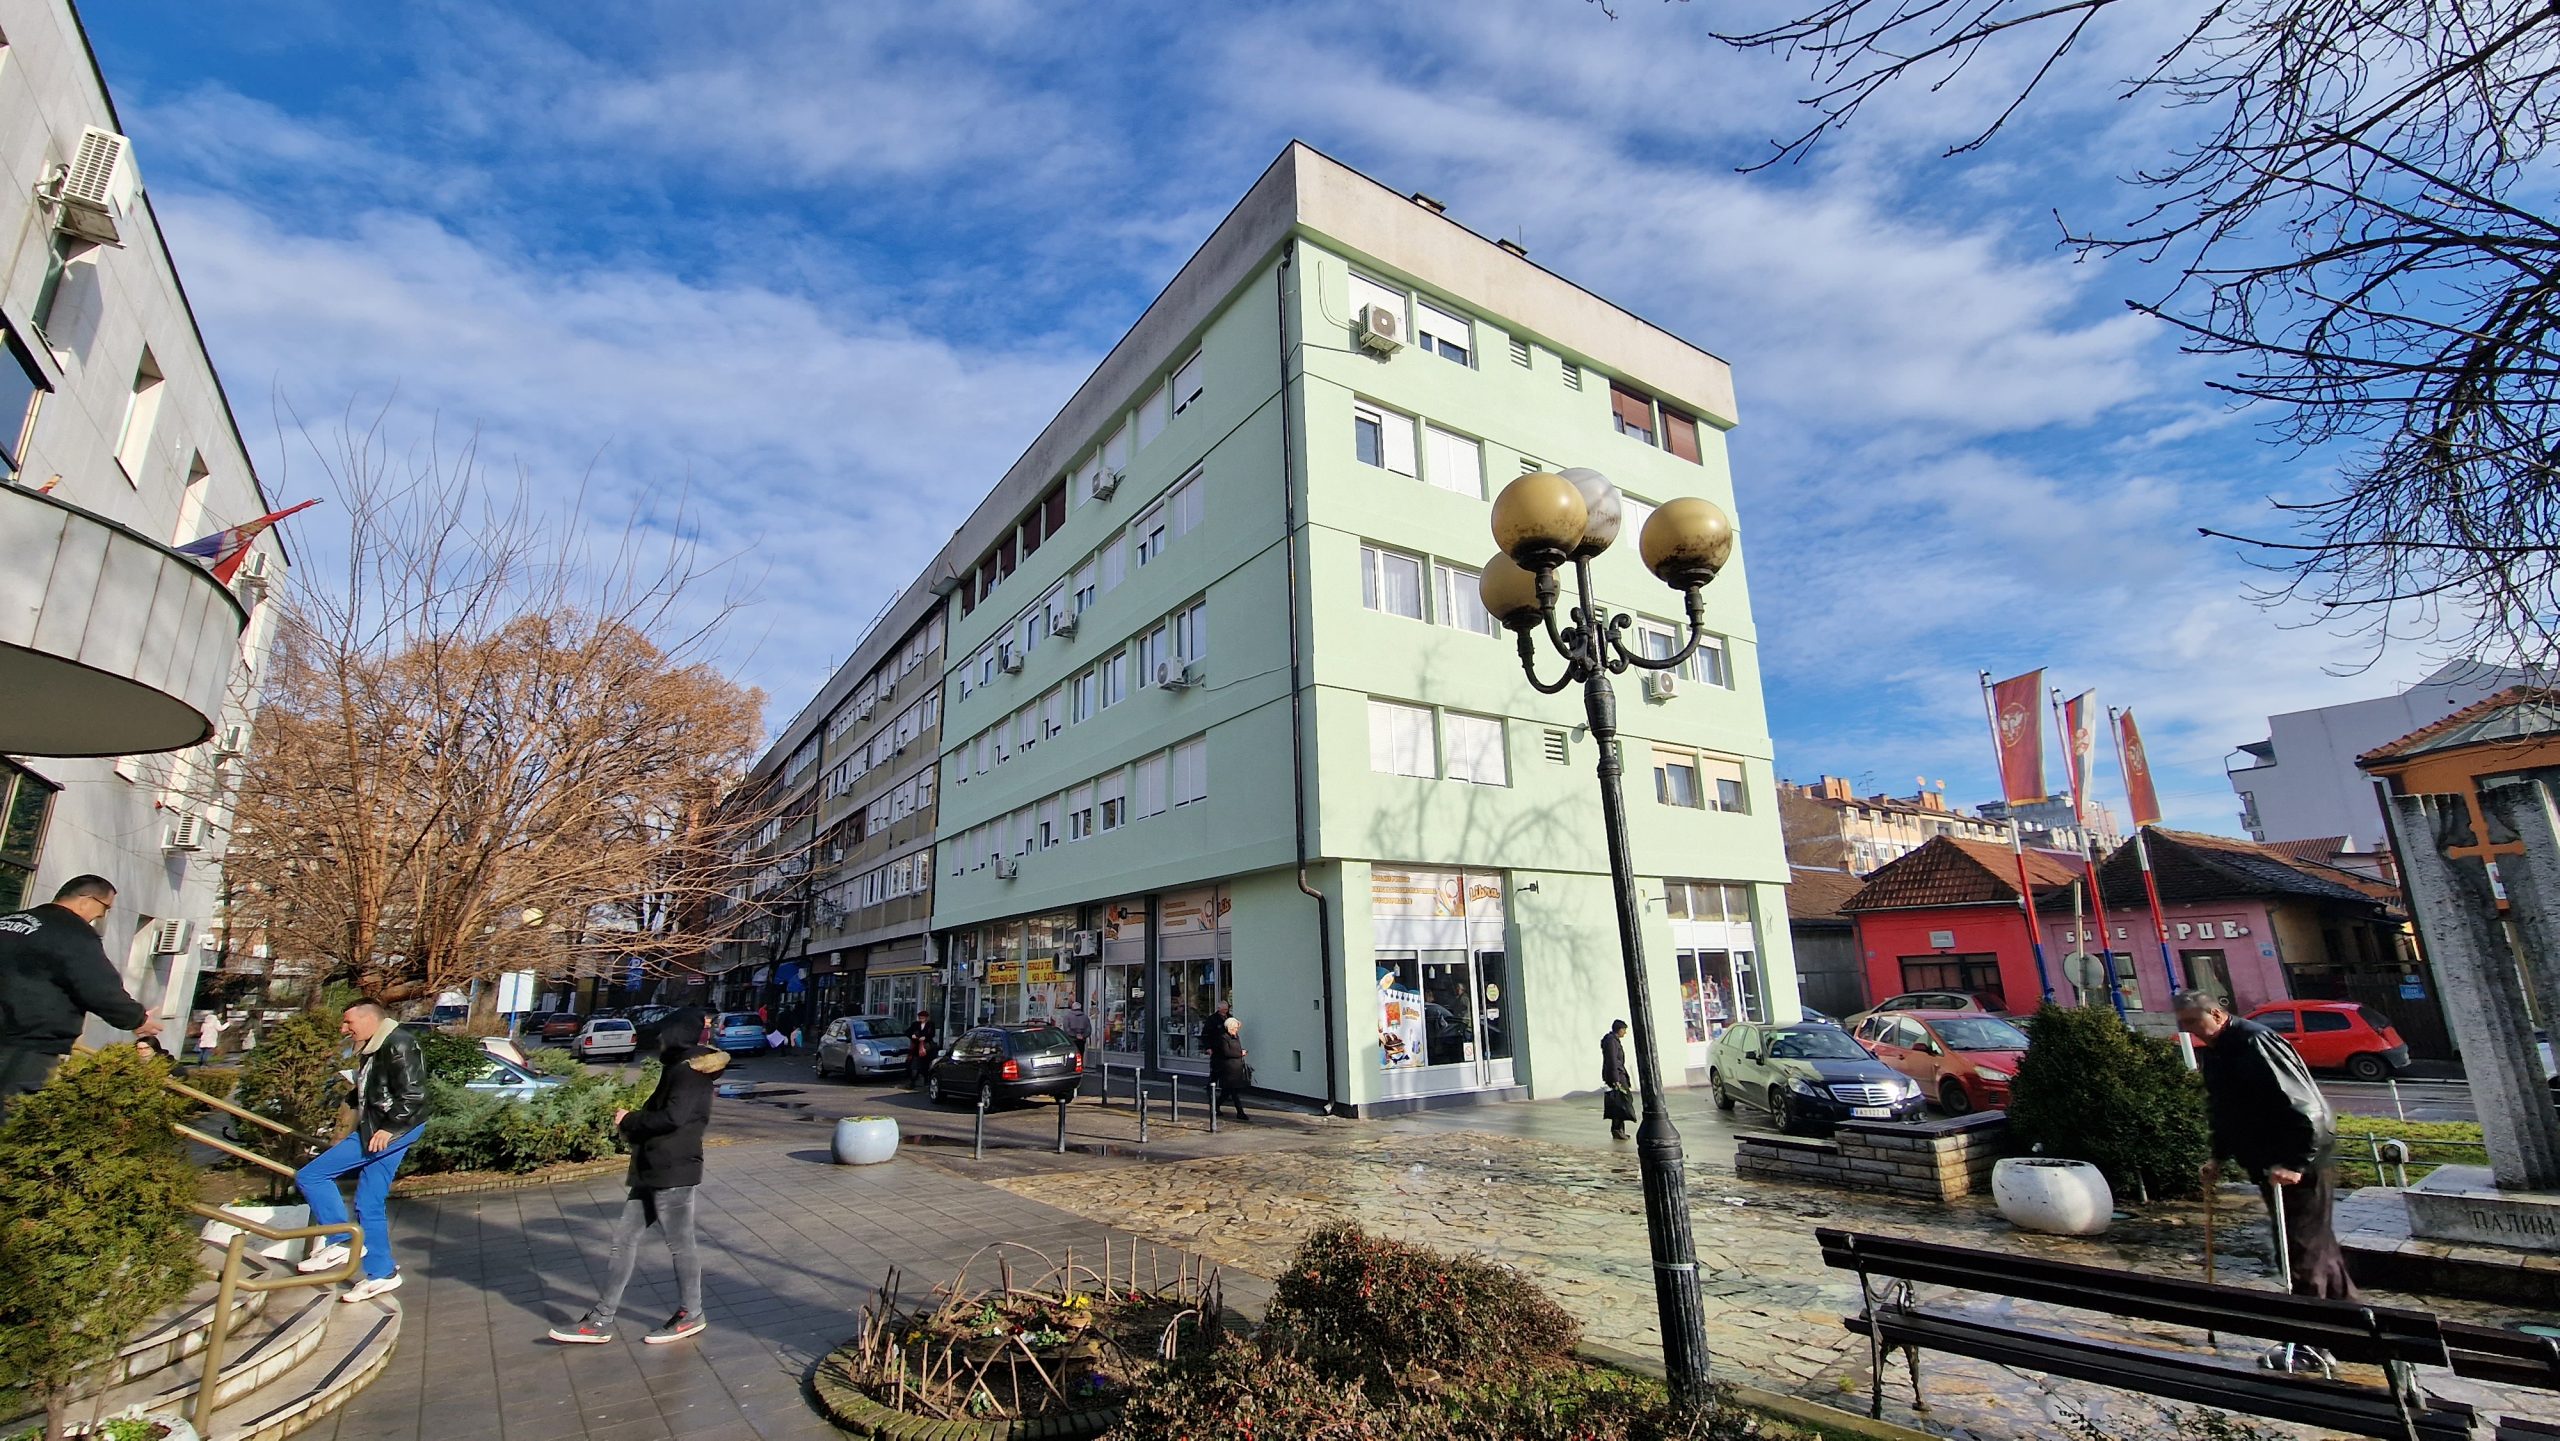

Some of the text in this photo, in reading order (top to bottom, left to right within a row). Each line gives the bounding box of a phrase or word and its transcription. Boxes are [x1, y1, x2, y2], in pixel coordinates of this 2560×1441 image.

[1469, 884, 1500, 901] Libra
[0, 920, 38, 935] ECURITY
[2472, 1211, 2556, 1236] ПАЛИМ
